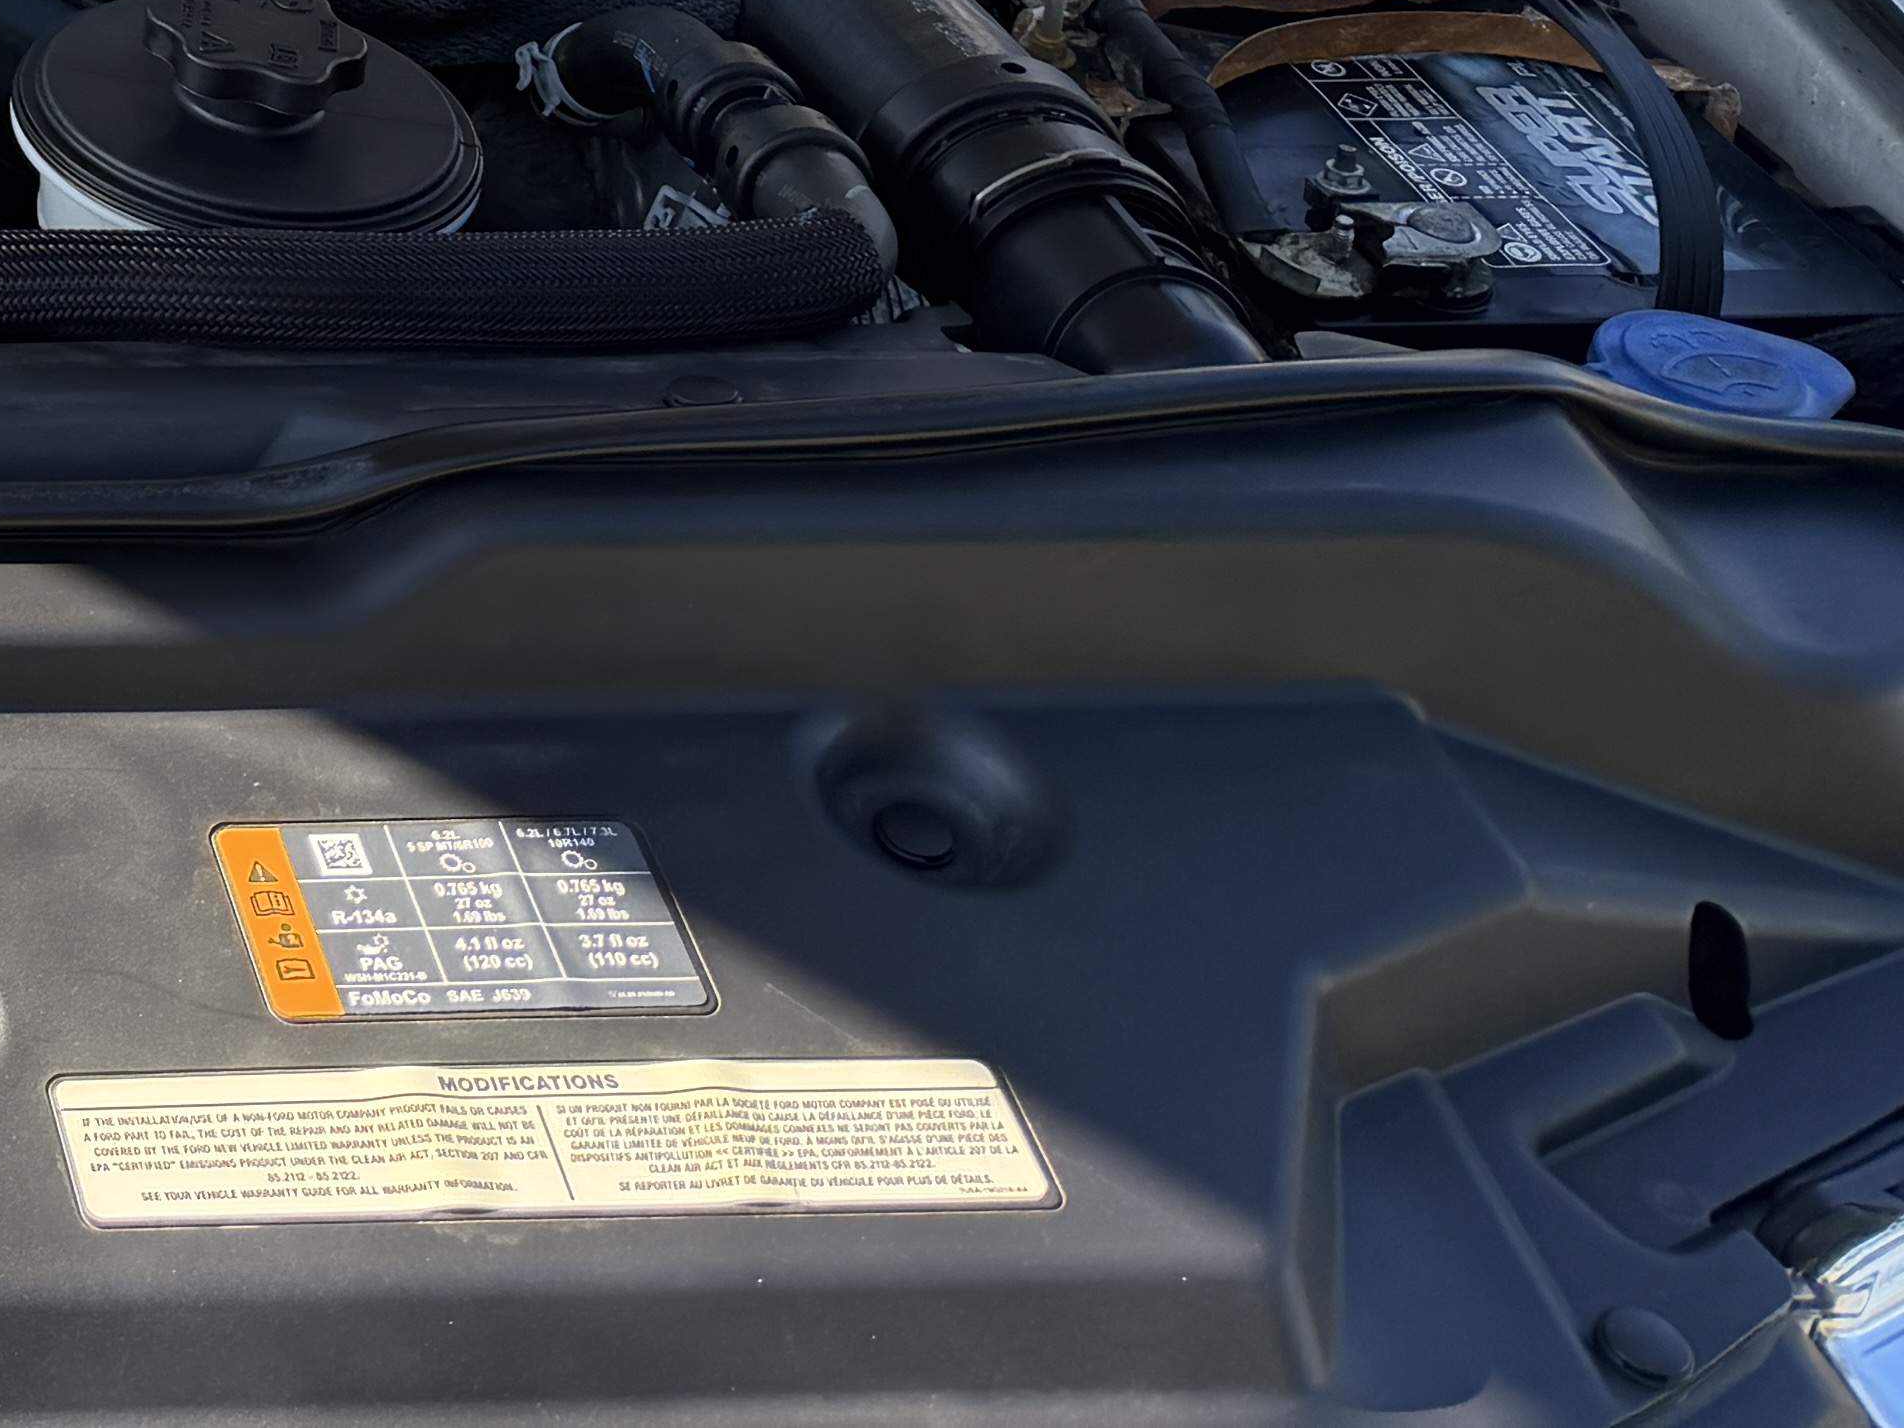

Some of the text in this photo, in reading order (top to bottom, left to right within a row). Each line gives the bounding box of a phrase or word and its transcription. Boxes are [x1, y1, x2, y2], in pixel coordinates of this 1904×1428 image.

[1476, 81, 1624, 215] SUPER
[433, 881, 503, 899] 0.765 kg
[556, 879, 626, 896] 0.765 kg
[454, 897, 493, 909] 27 oz
[578, 894, 616, 907] 27 oz
[331, 910, 398, 926] R-134a
[482, 910, 507, 923] lbs
[454, 935, 526, 951] 4.1 fl oz
[578, 933, 650, 948] 3.7 fl oz
[359, 956, 404, 972] PAG
[463, 953, 534, 972] (120 cc)
[588, 951, 660, 969] (110 cc)
[348, 988, 532, 1006] FoMoCo SAE J639
[437, 1075, 620, 1093] MODIFICATIONS
